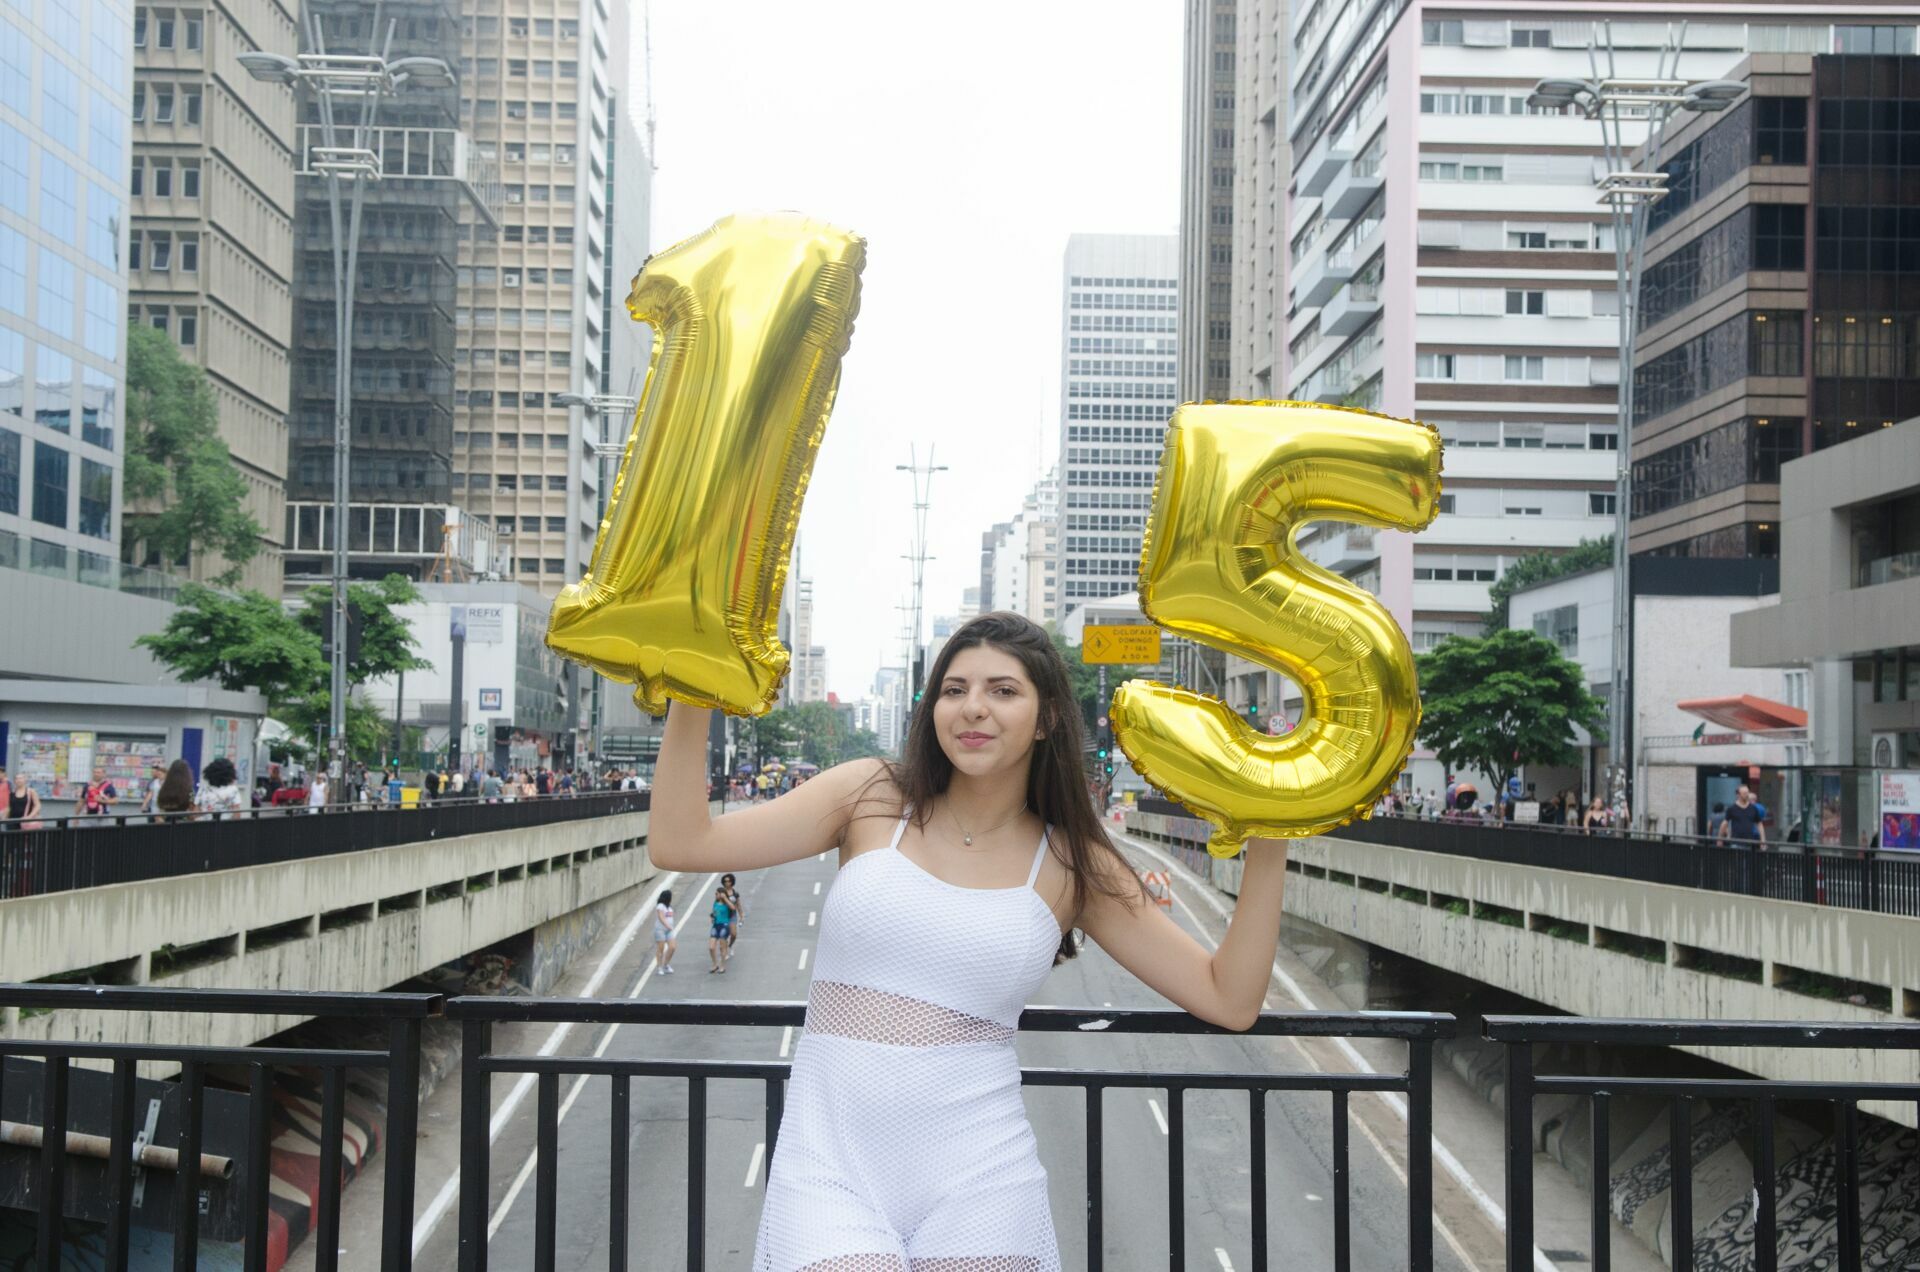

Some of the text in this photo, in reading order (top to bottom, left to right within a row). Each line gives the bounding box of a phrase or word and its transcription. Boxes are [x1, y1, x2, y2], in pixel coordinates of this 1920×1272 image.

[545, 210, 1445, 859] 1 5
[468, 608, 501, 617] REFIX
[1271, 718, 1285, 728] 50
